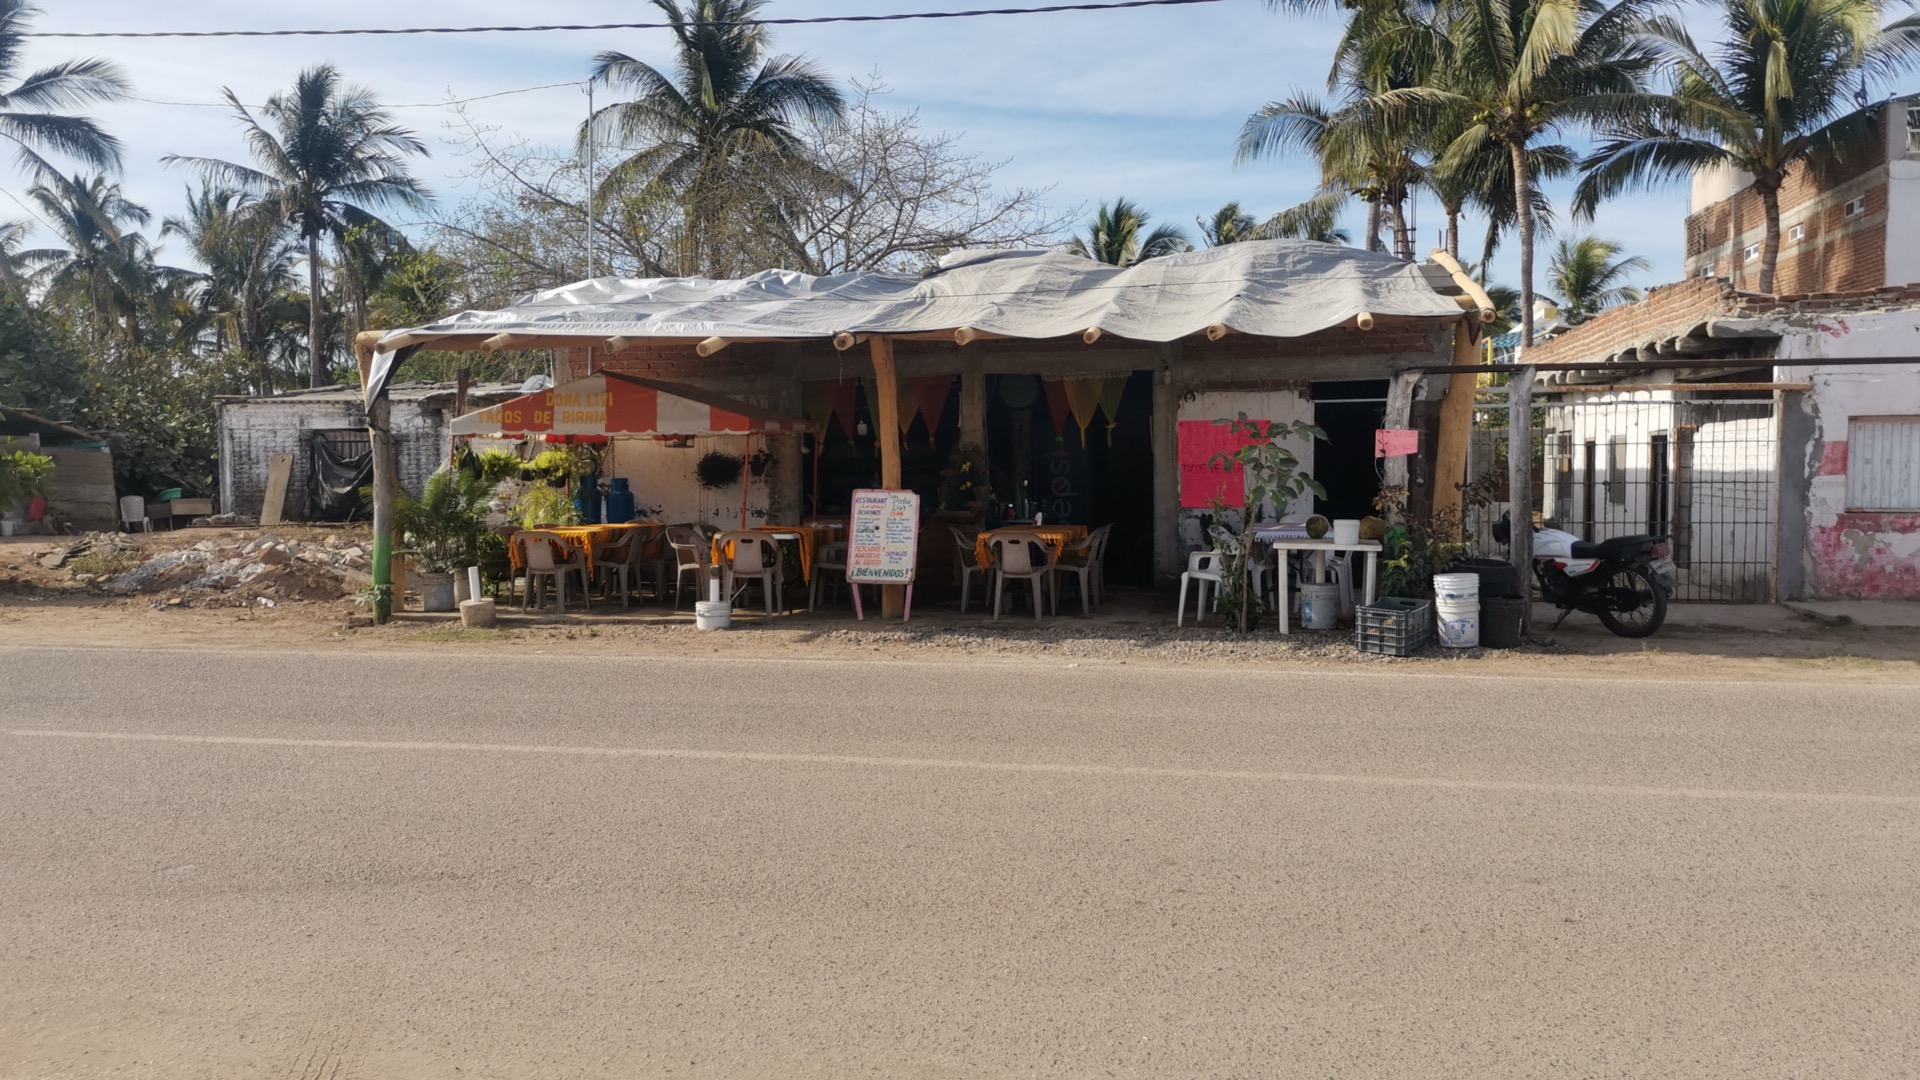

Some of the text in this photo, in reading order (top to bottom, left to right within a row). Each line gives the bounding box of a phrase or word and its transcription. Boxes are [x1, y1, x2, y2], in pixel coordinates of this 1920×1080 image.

[587, 391, 613, 407] LIVI
[479, 410, 608, 425] TACOS DE BIRRIA
[1182, 464, 1206, 474] TACOS
[1044, 451, 1077, 525] epsi
